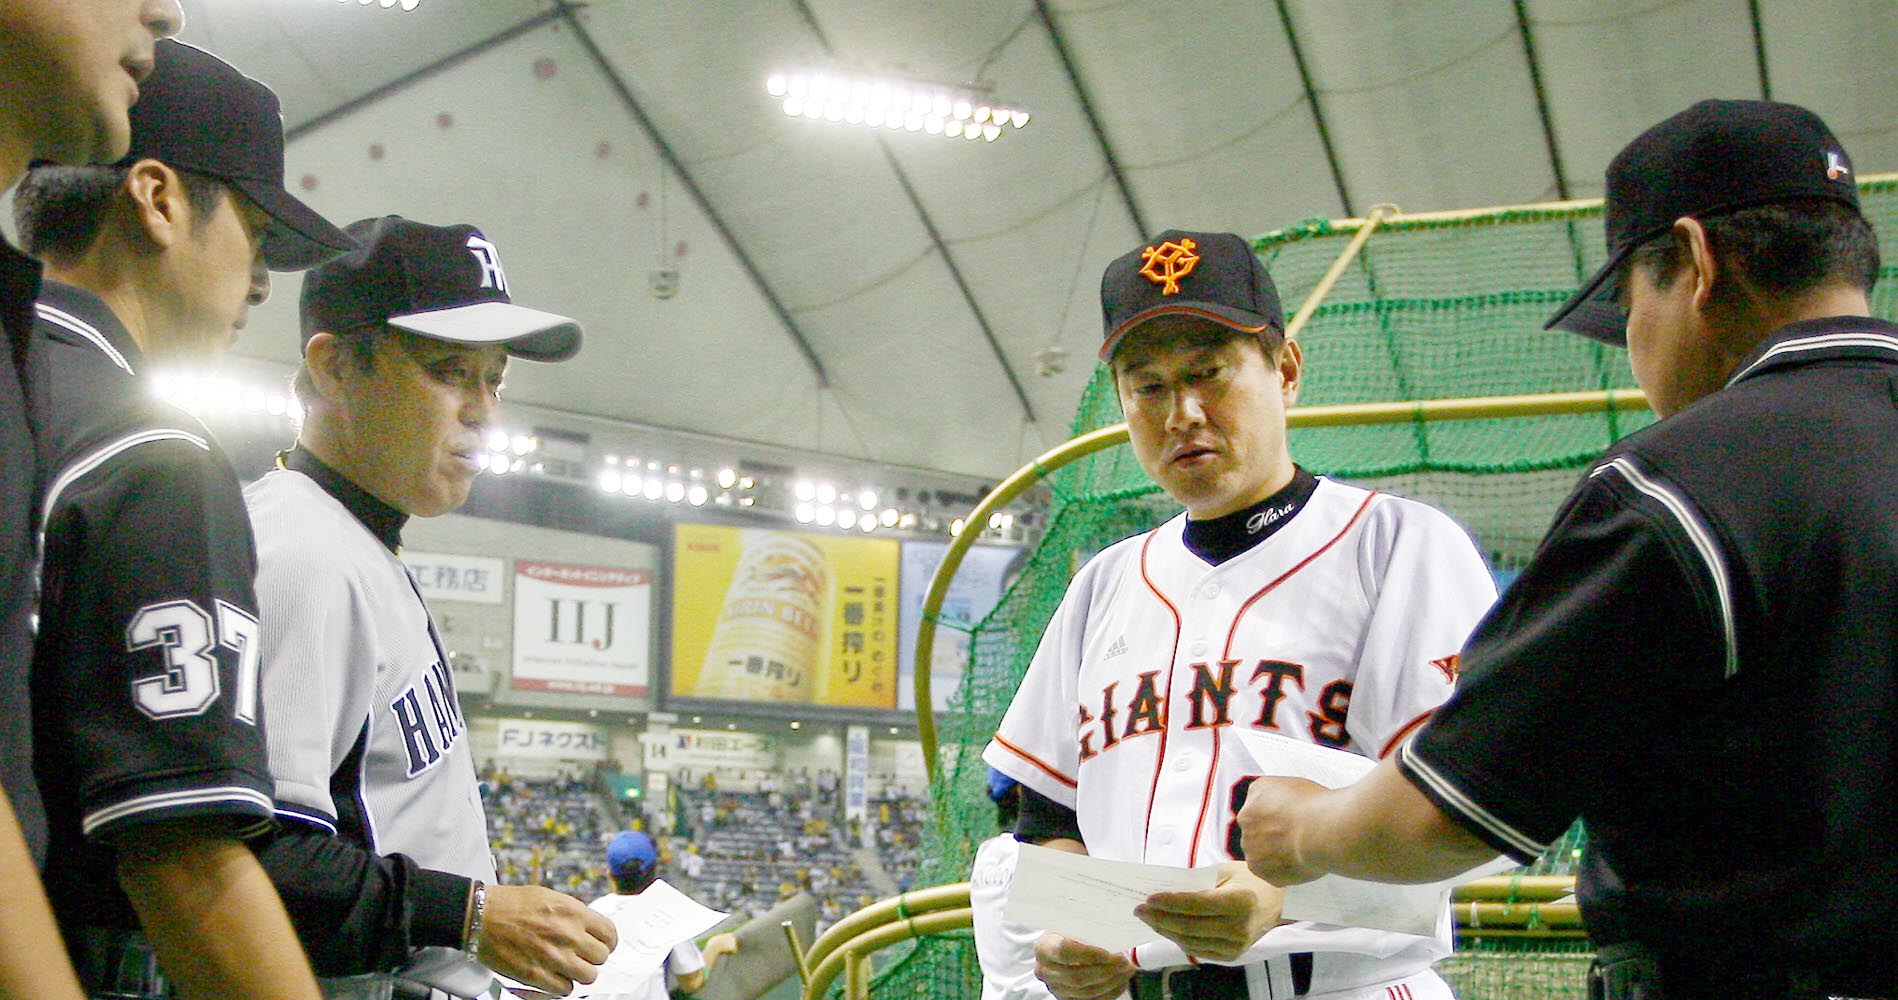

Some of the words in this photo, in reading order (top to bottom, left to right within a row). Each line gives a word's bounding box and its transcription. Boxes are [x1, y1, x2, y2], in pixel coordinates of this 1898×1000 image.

[125, 598, 260, 727] 37
[545, 598, 621, 651] IIJ
[842, 586, 864, 683] 一番搾り
